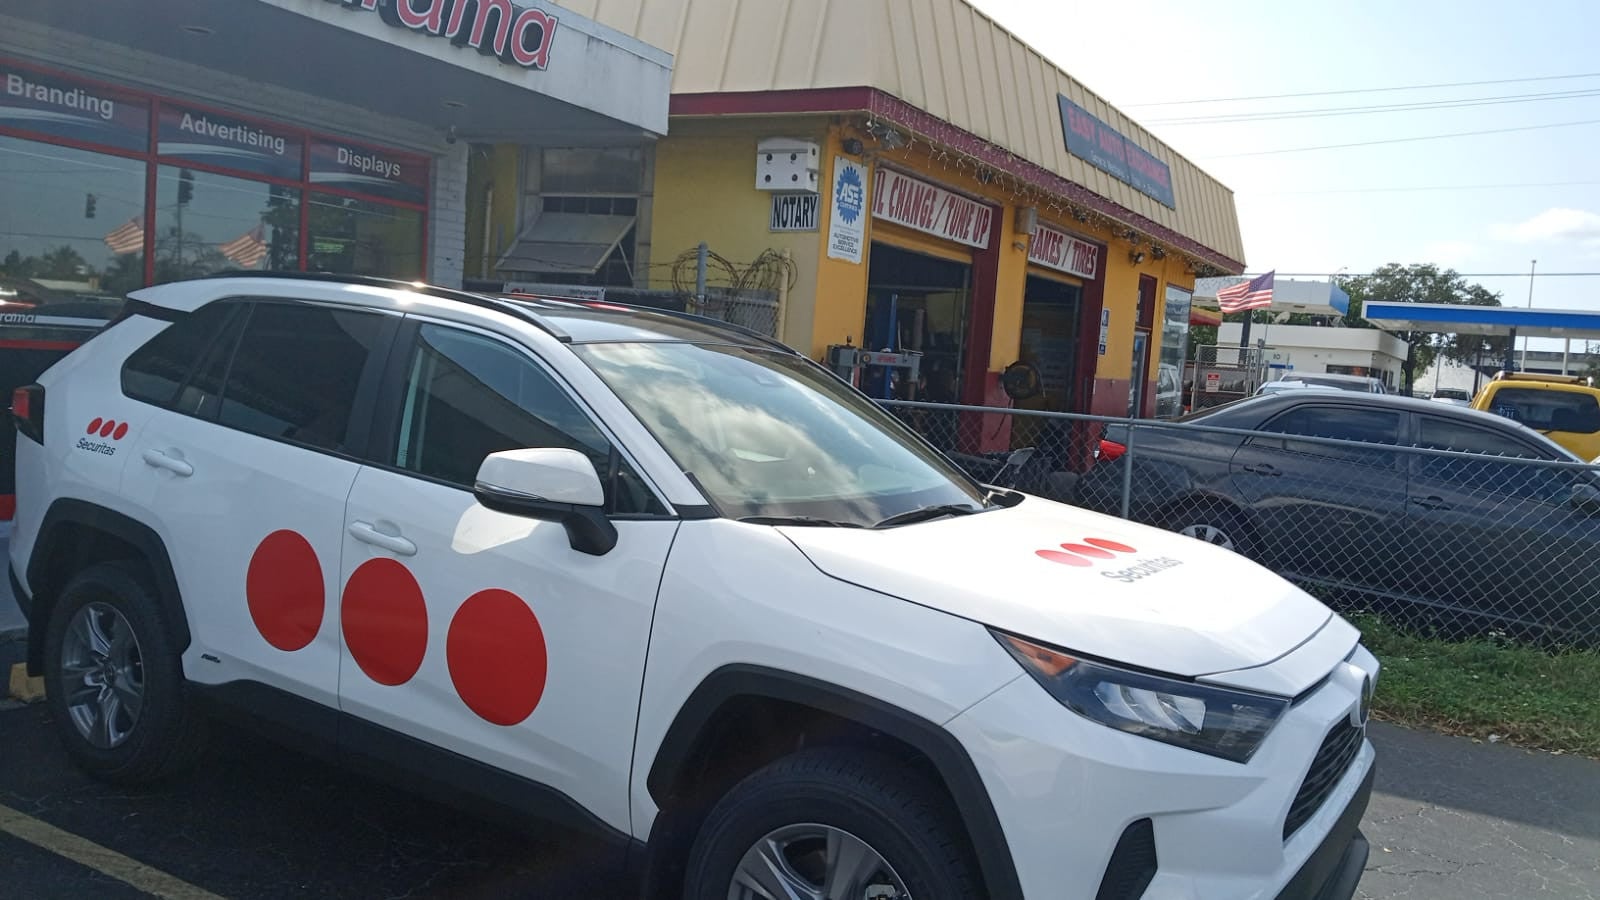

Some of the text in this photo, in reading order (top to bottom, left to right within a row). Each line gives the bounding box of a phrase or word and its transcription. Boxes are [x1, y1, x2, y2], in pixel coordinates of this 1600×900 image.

[361, 0, 558, 71] ama
[7, 73, 114, 119] Branding
[179, 112, 285, 154] Advertising
[337, 148, 401, 178] Displays
[839, 182, 859, 206] ASE
[873, 169, 886, 215] IL
[888, 175, 938, 230] CHANGE
[943, 194, 976, 240] TUNE
[973, 207, 990, 244] UP
[772, 195, 818, 229] NOTARY
[1071, 240, 1098, 276] TIRES
[76, 437, 117, 456] Securitas
[1100, 557, 1184, 583] Securitas
